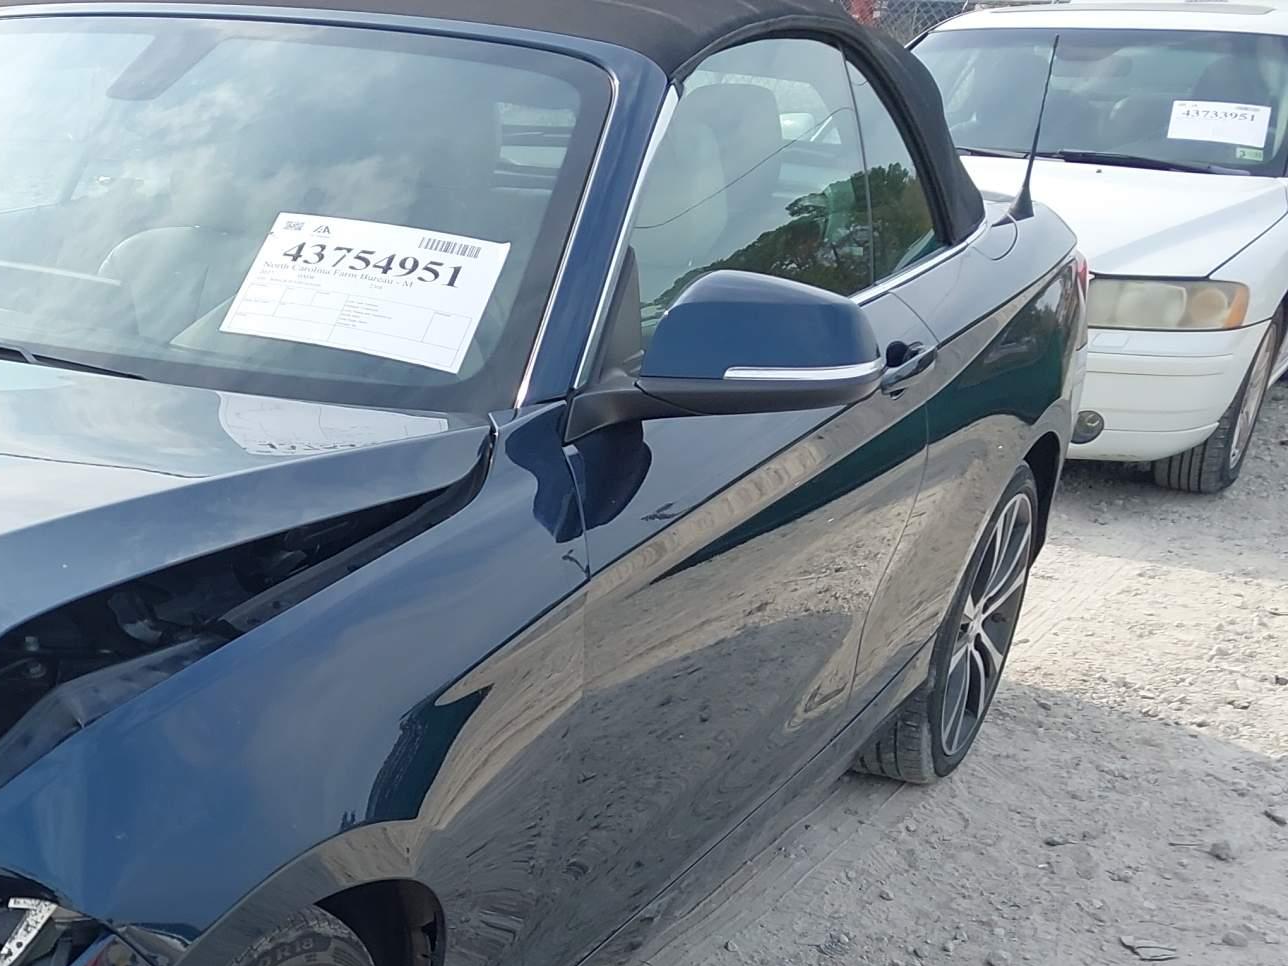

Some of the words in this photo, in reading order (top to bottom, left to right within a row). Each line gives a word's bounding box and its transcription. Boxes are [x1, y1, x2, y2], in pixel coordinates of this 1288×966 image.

[1182, 109, 1255, 122] 43733951
[264, 261, 289, 271] North
[292, 264, 331, 275] Carolina
[333, 268, 357, 279] Farm
[360, 273, 393, 285] Bureau
[283, 241, 463, 288] 43754951
